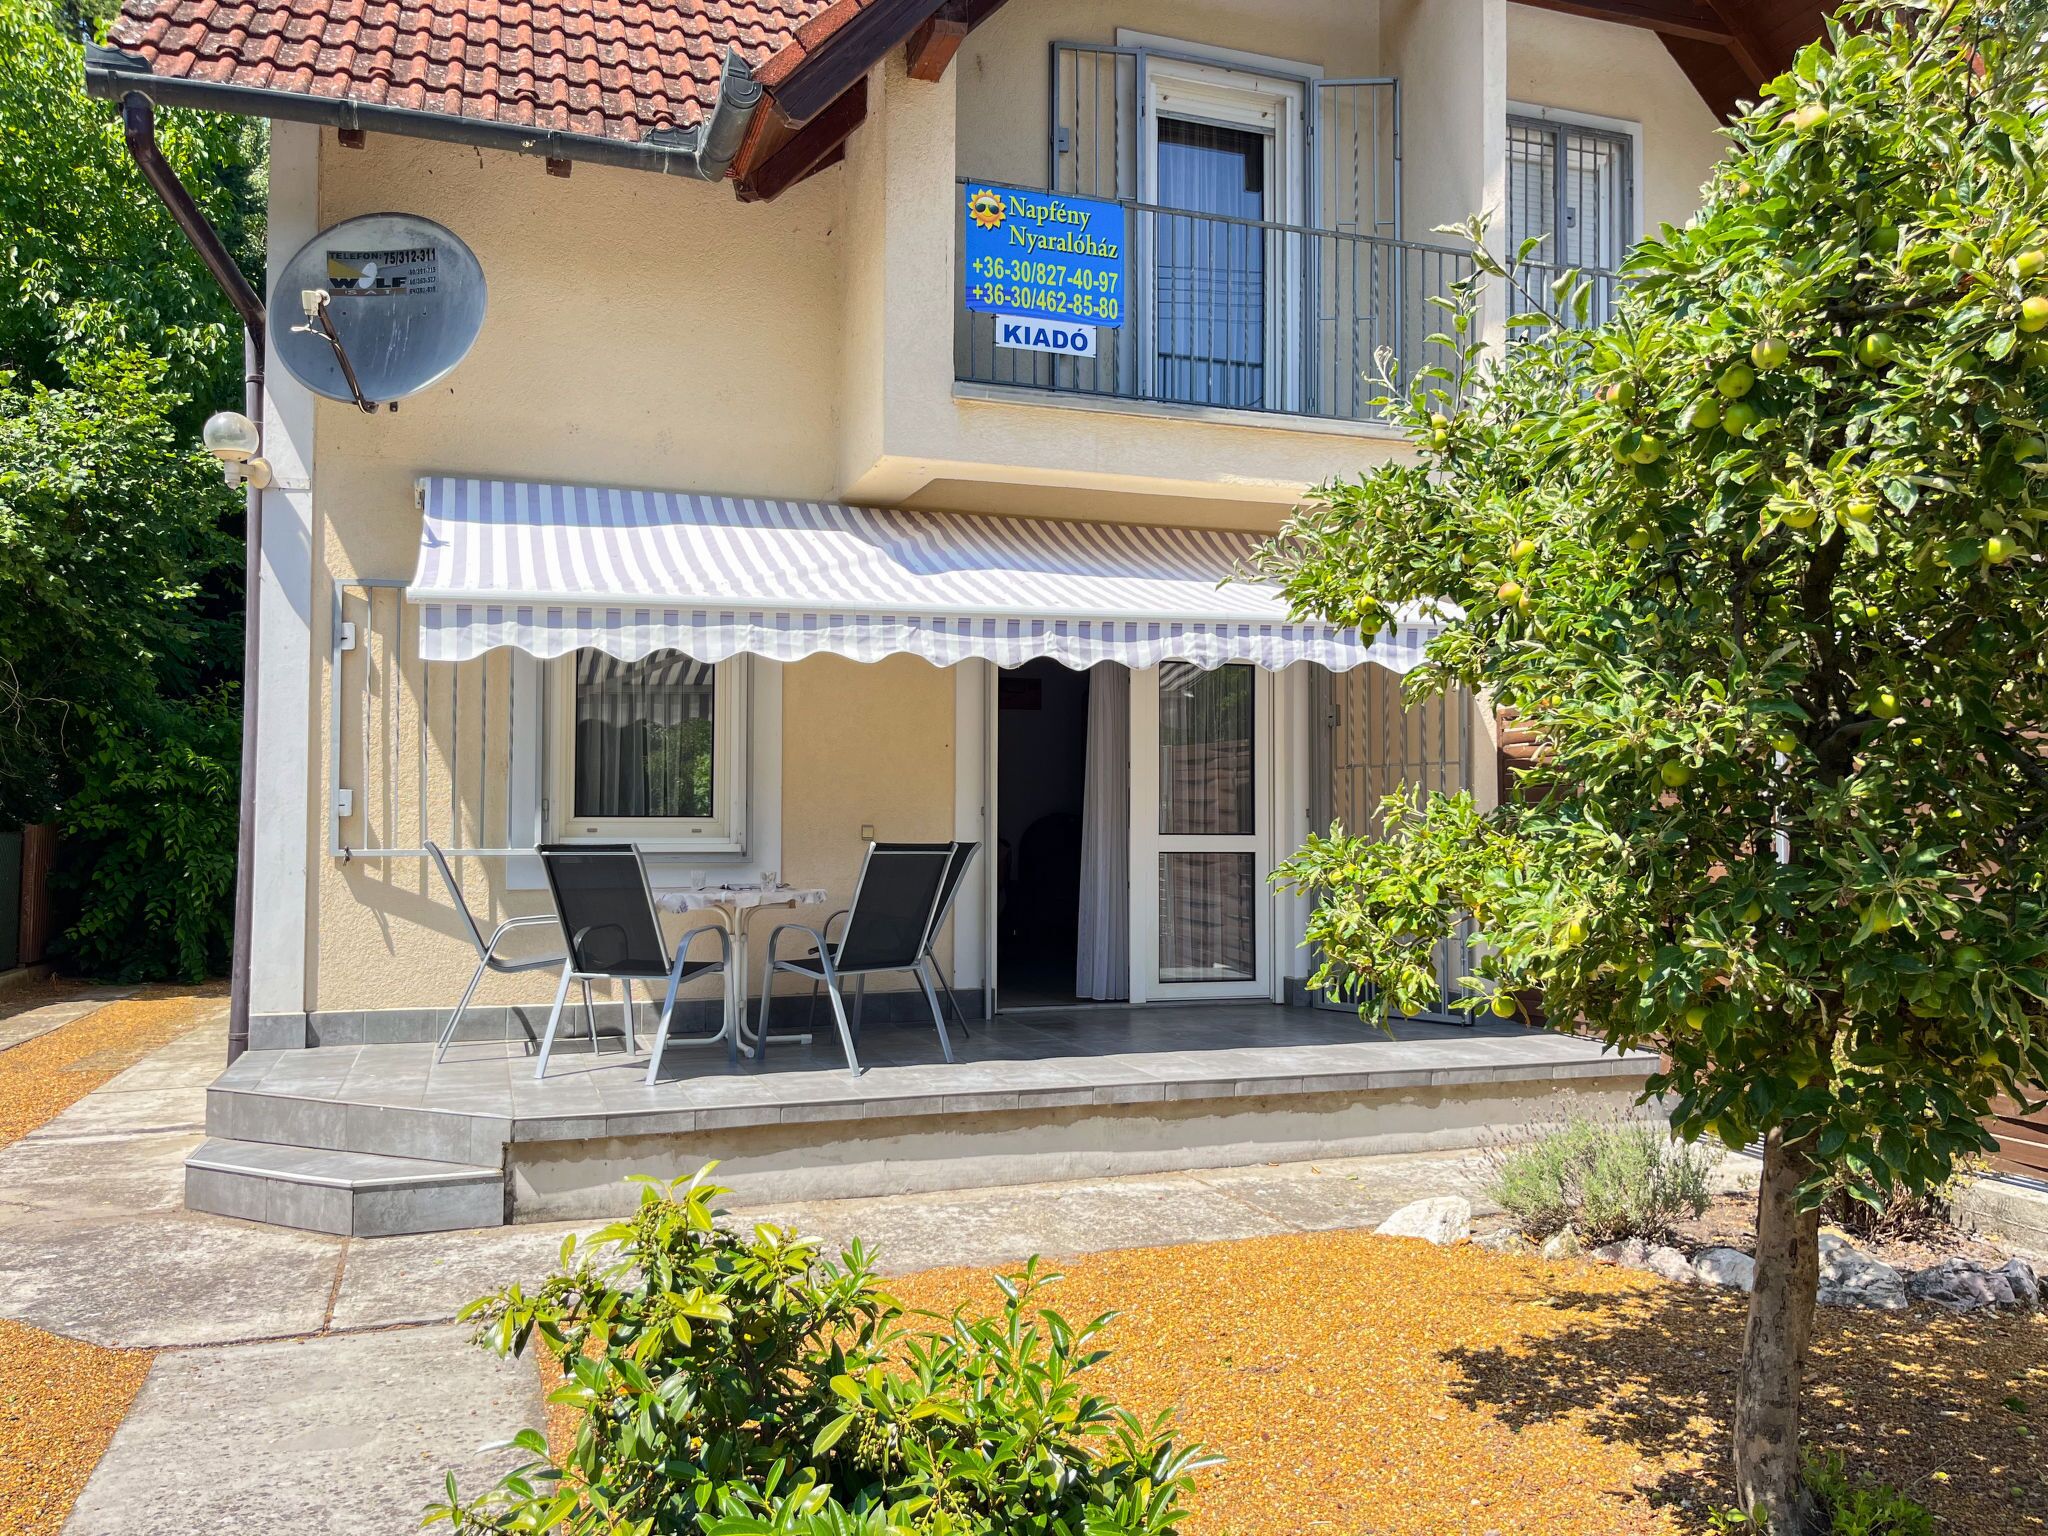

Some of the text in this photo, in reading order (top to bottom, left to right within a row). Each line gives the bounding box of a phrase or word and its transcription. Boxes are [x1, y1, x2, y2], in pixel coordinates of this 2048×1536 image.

[1009, 196, 1091, 231] Napfény
[329, 248, 436, 265] TELEFON: 75/312-311
[1009, 225, 1118, 259] Nyaralóház
[973, 256, 1118, 293] +36-30/827-40-97
[973, 283, 1118, 319] +36-30/462-85-80
[1004, 324, 1088, 351] KIADÓ
